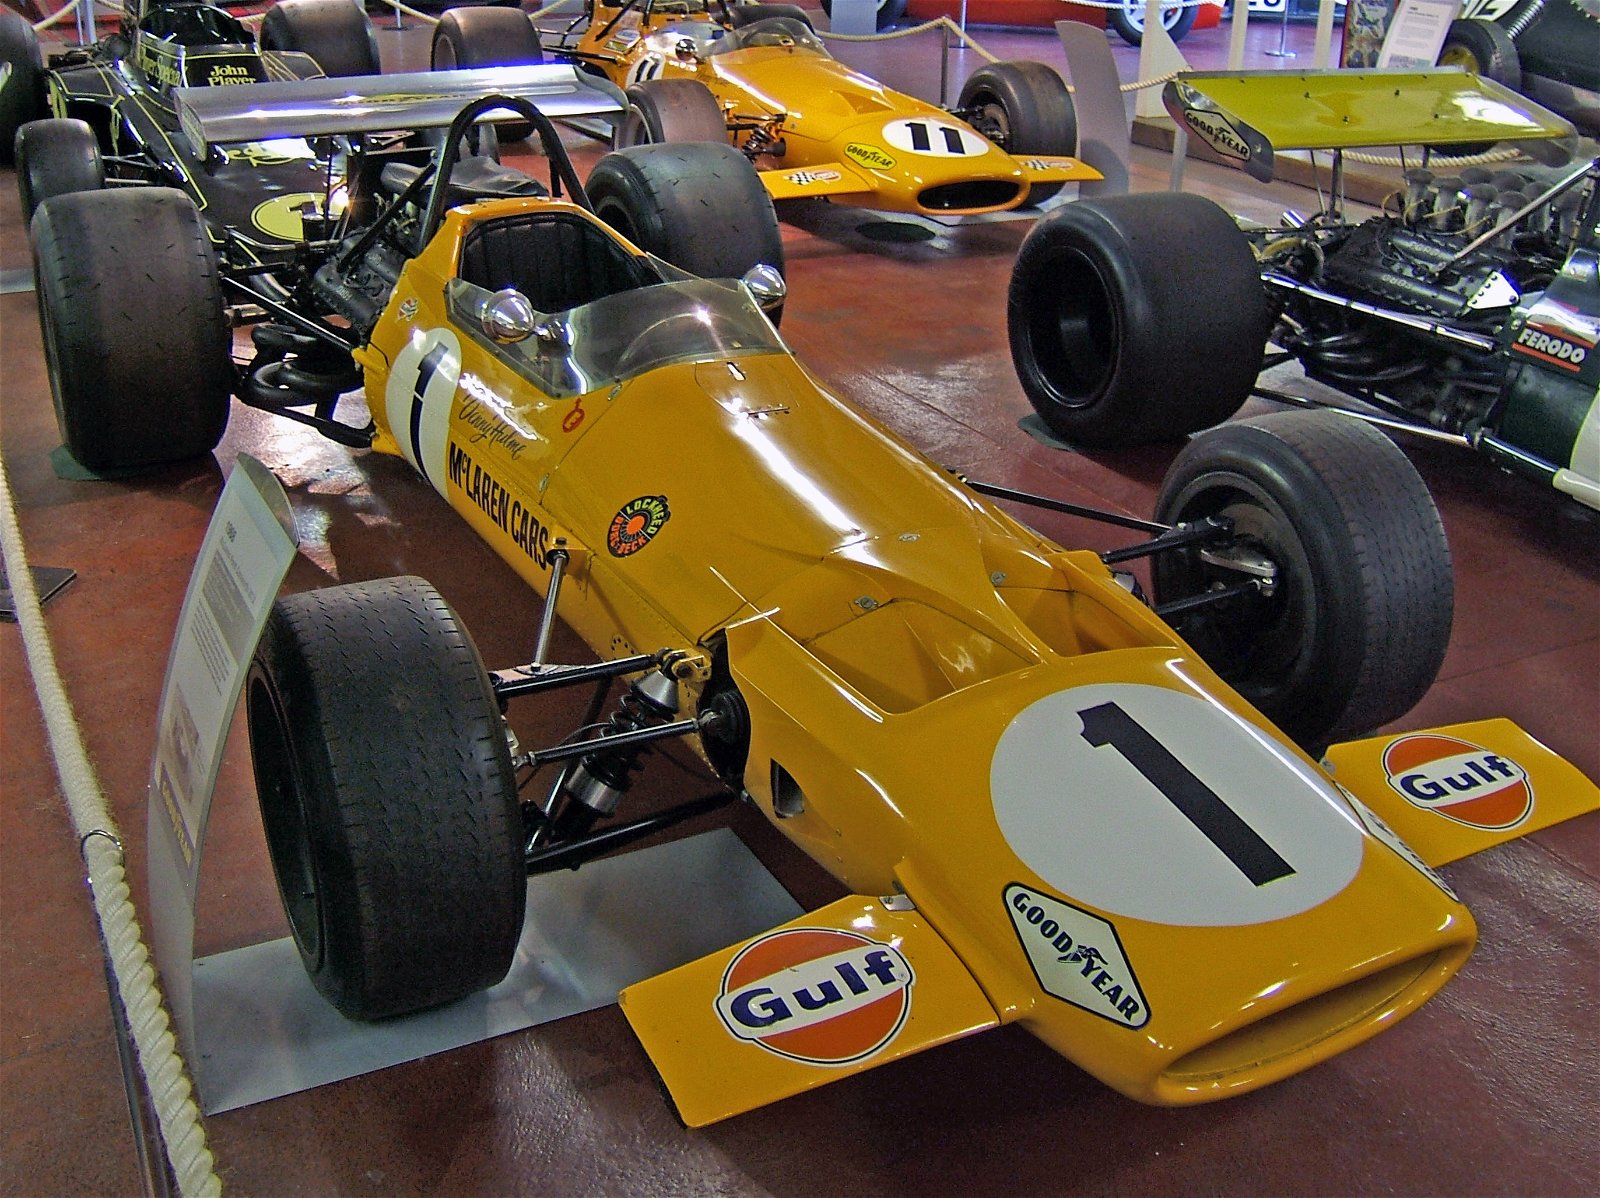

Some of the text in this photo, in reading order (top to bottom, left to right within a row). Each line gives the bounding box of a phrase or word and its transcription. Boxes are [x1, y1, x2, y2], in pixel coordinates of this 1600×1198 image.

[207, 76, 257, 88] Player
[210, 64, 249, 77] John
[846, 144, 894, 167] GOODYEAR
[904, 121, 967, 155] 11
[1185, 112, 1249, 157] GOODYEAR
[1517, 327, 1586, 364] FERODO
[410, 340, 449, 500] 1
[485, 413, 528, 461] Hulme
[511, 500, 549, 571] CARS
[626, 498, 665, 535] LOCKHEED
[1076, 701, 1297, 887] 1
[1400, 755, 1515, 801] Gulf
[1012, 892, 1140, 1022] GOODYEAR
[730, 950, 896, 1028] Gulf
